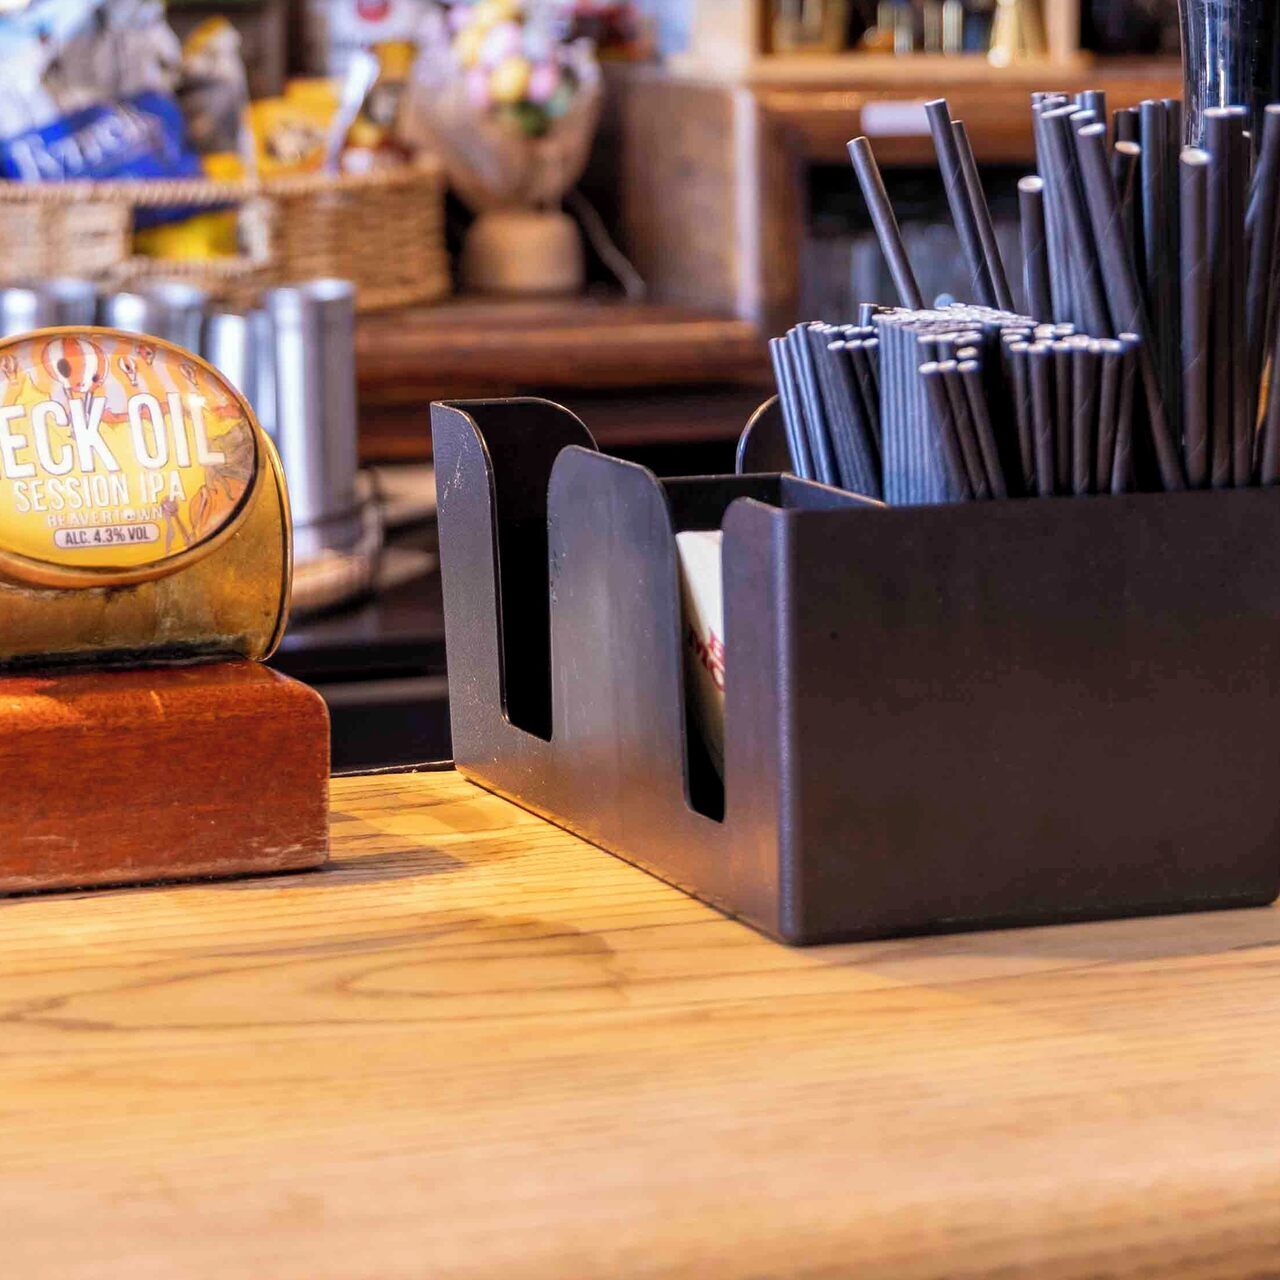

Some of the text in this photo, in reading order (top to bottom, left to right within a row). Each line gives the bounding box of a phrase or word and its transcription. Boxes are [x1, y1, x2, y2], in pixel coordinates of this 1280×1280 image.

[128, 392, 226, 469] OIL
[14, 470, 187, 513] SESSION IPA
[65, 526, 150, 545] ALC. 4.3% VOL
